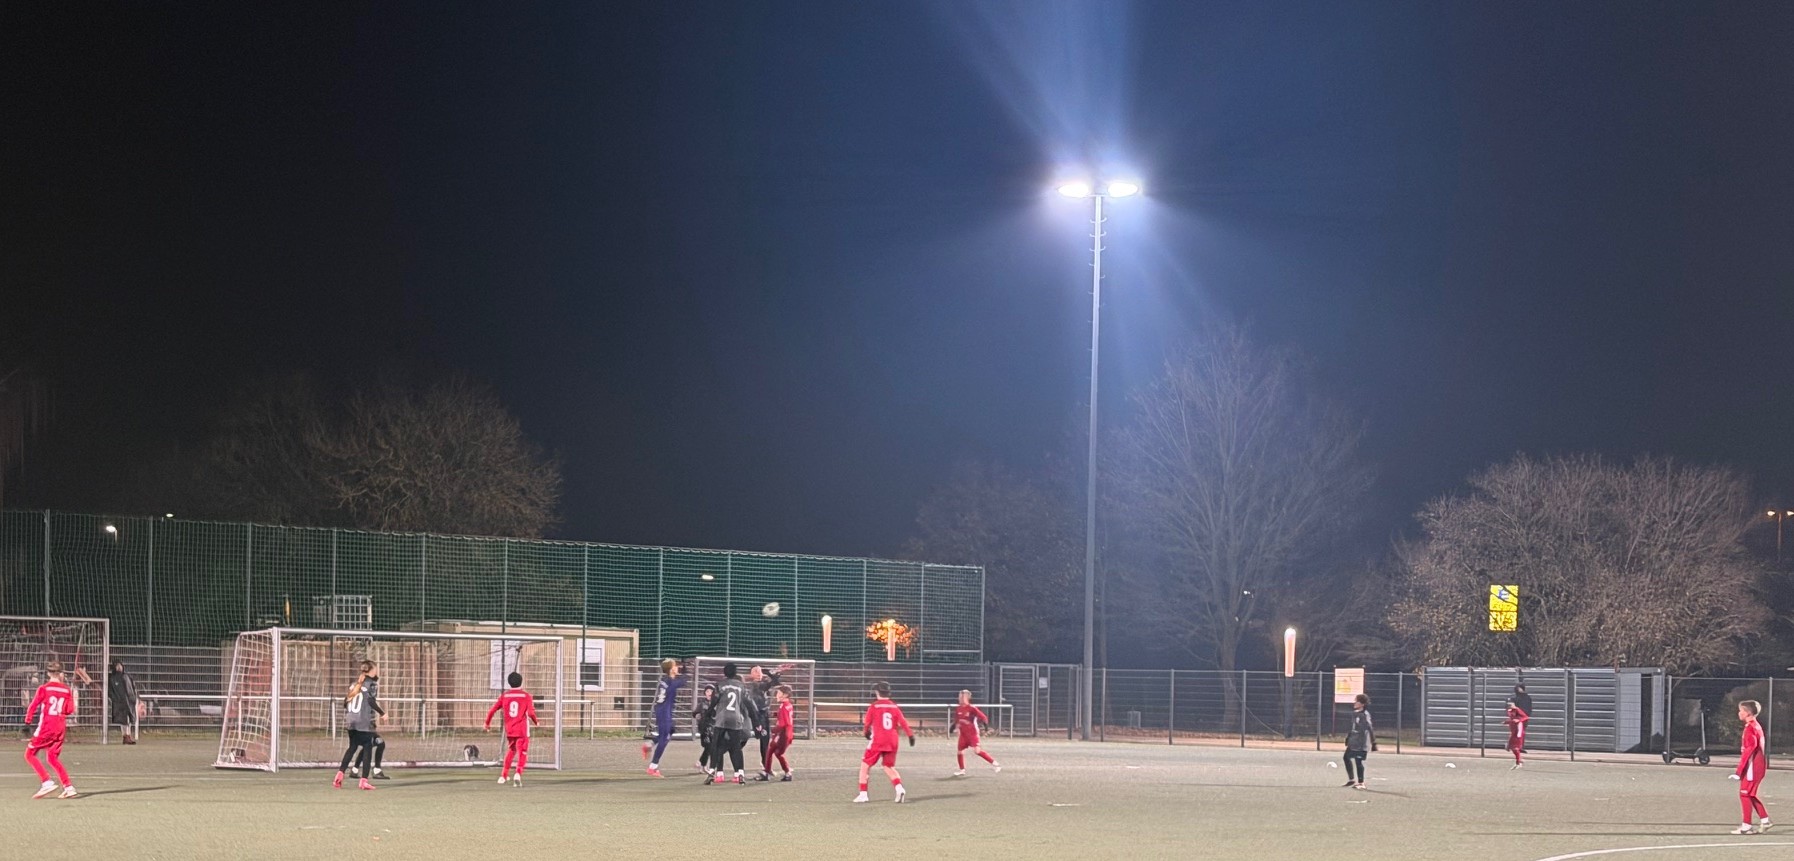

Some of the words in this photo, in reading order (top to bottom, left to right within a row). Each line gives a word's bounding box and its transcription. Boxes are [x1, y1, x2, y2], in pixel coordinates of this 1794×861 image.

[509, 700, 519, 718] 9
[726, 691, 737, 711] 2
[882, 711, 893, 730] 6
